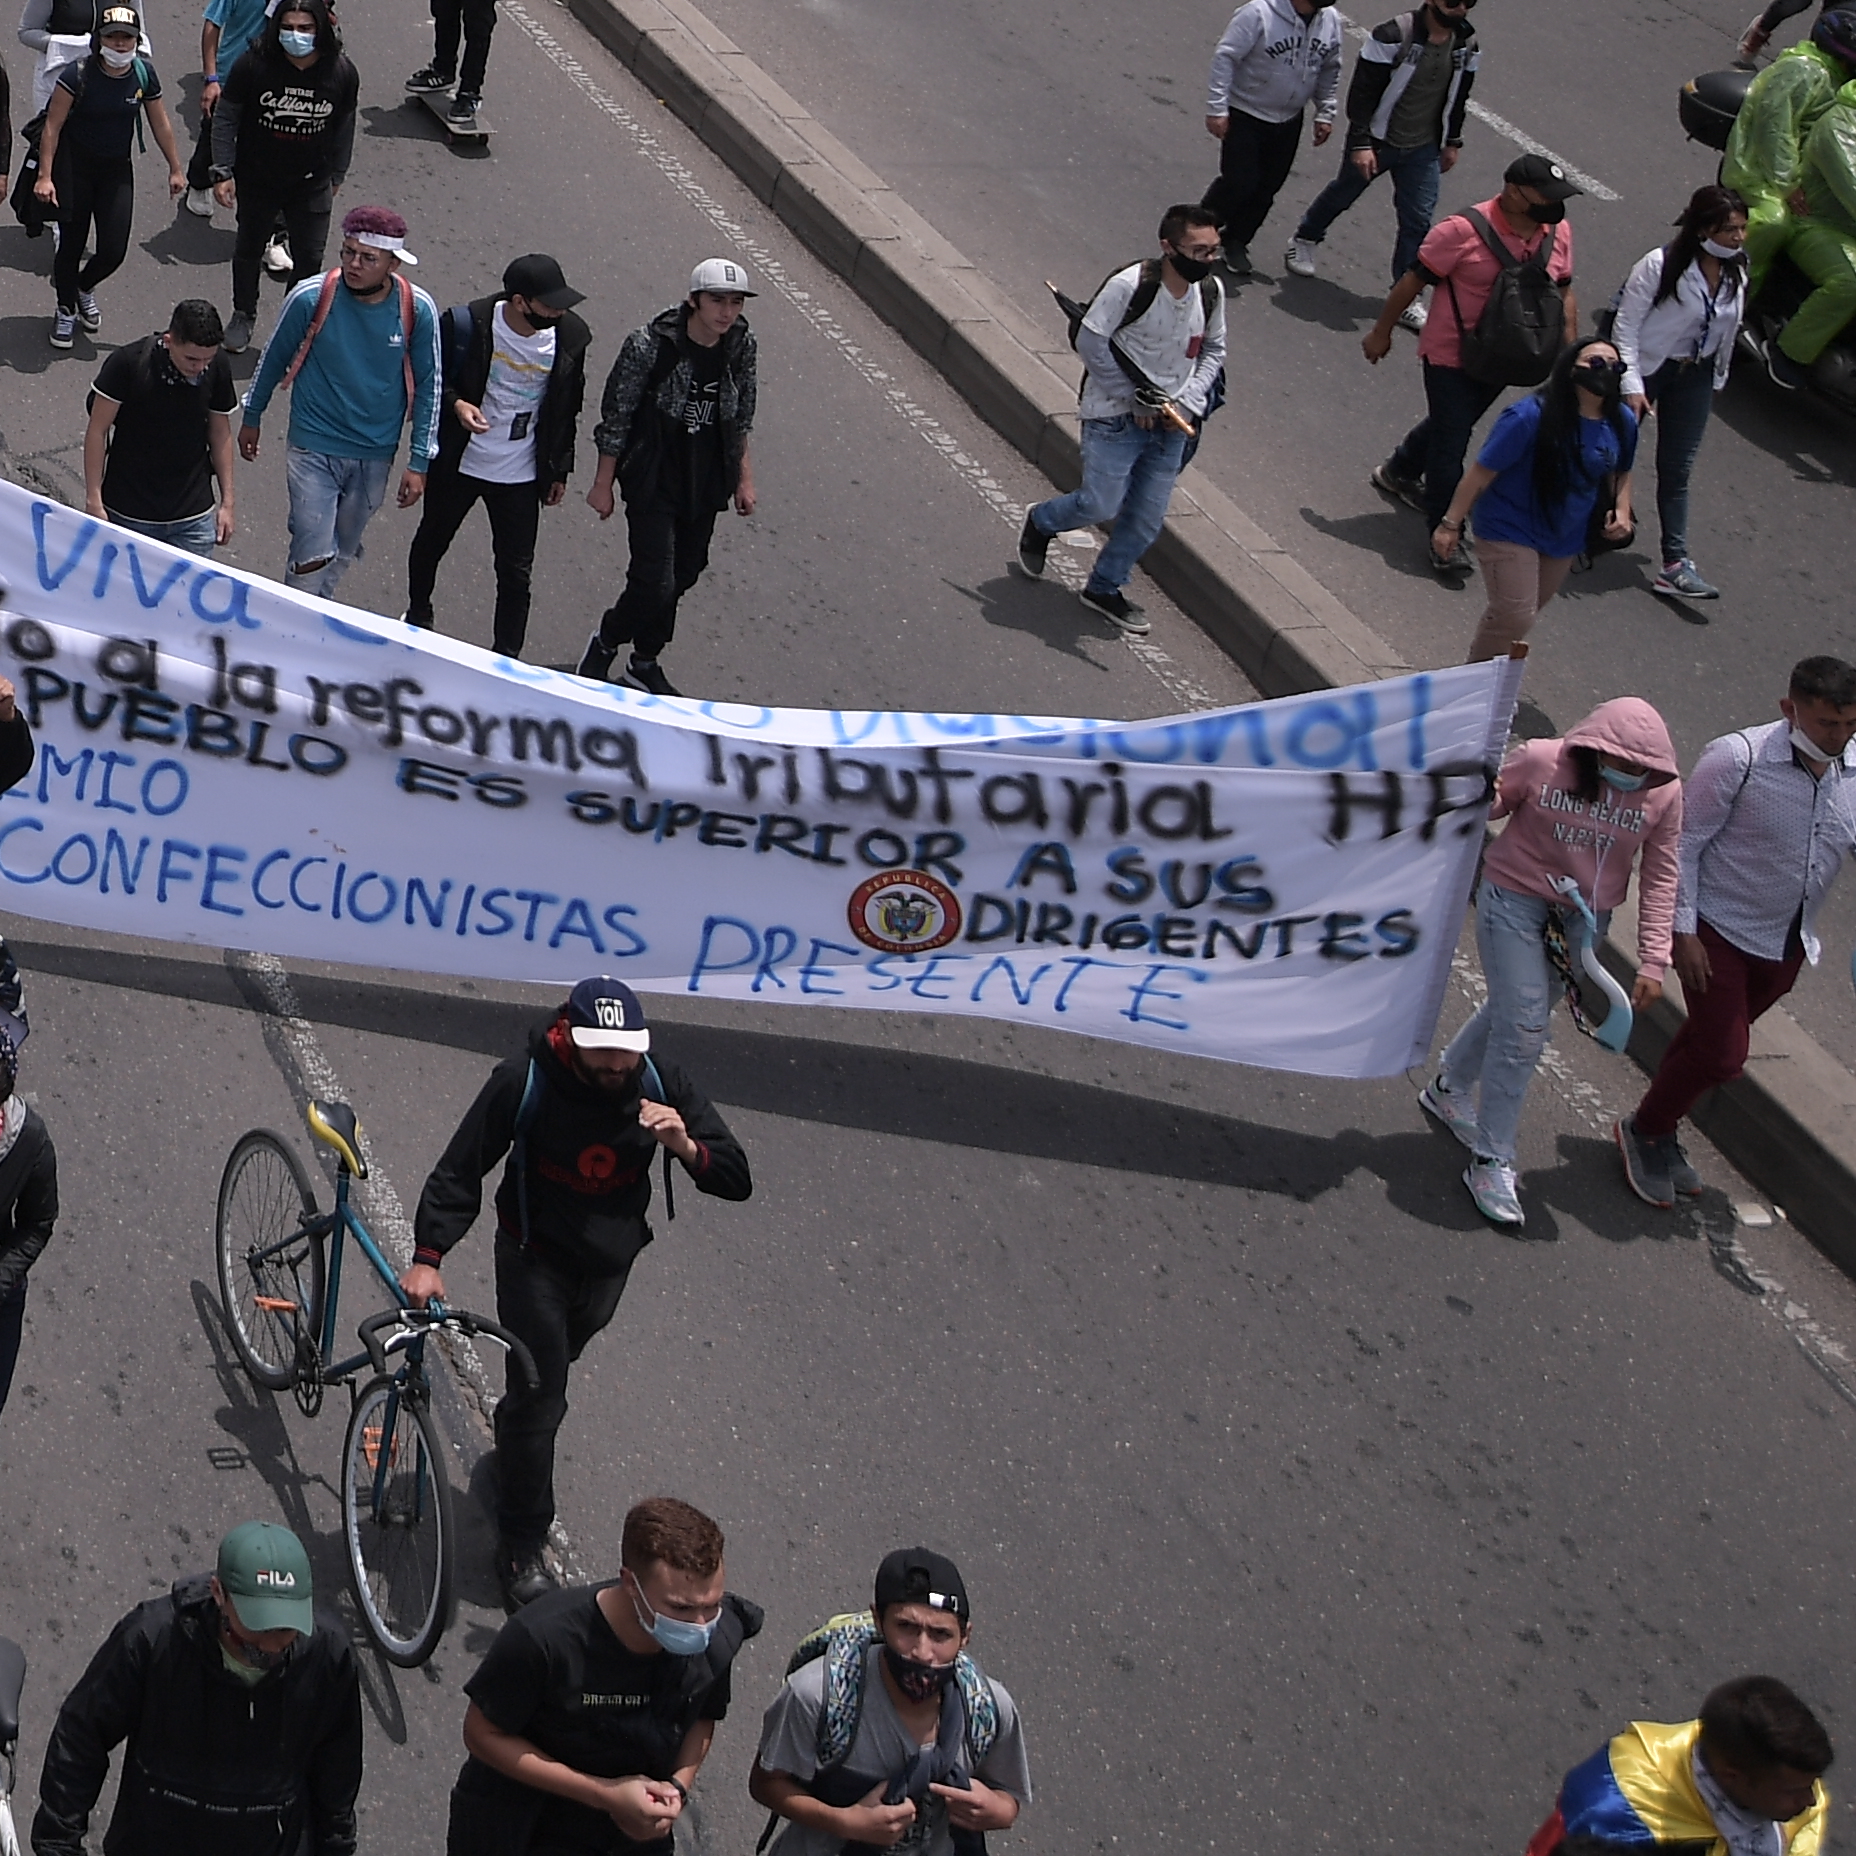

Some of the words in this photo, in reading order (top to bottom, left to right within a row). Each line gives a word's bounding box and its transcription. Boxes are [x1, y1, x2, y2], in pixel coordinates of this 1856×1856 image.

[102, 5, 135, 25] SWAT
[259, 91, 334, 114] California
[31, 500, 262, 630] Viva
[96, 637, 159, 692] a
[208, 634, 281, 713] la
[305, 674, 650, 791] reforma
[21, 664, 350, 776] PUEBLO
[397, 756, 531, 811] ES
[564, 790, 967, 888] SUPERIOR
[1006, 843, 1080, 896] A
[1104, 845, 1275, 914] SUS
[1539, 781, 1585, 815] LONG
[963, 890, 1422, 963] DIRIGENTES
[686, 914, 1209, 1031] PRESENTE
[594, 1003, 626, 1028] YOU
[256, 1568, 297, 1588] FILA
